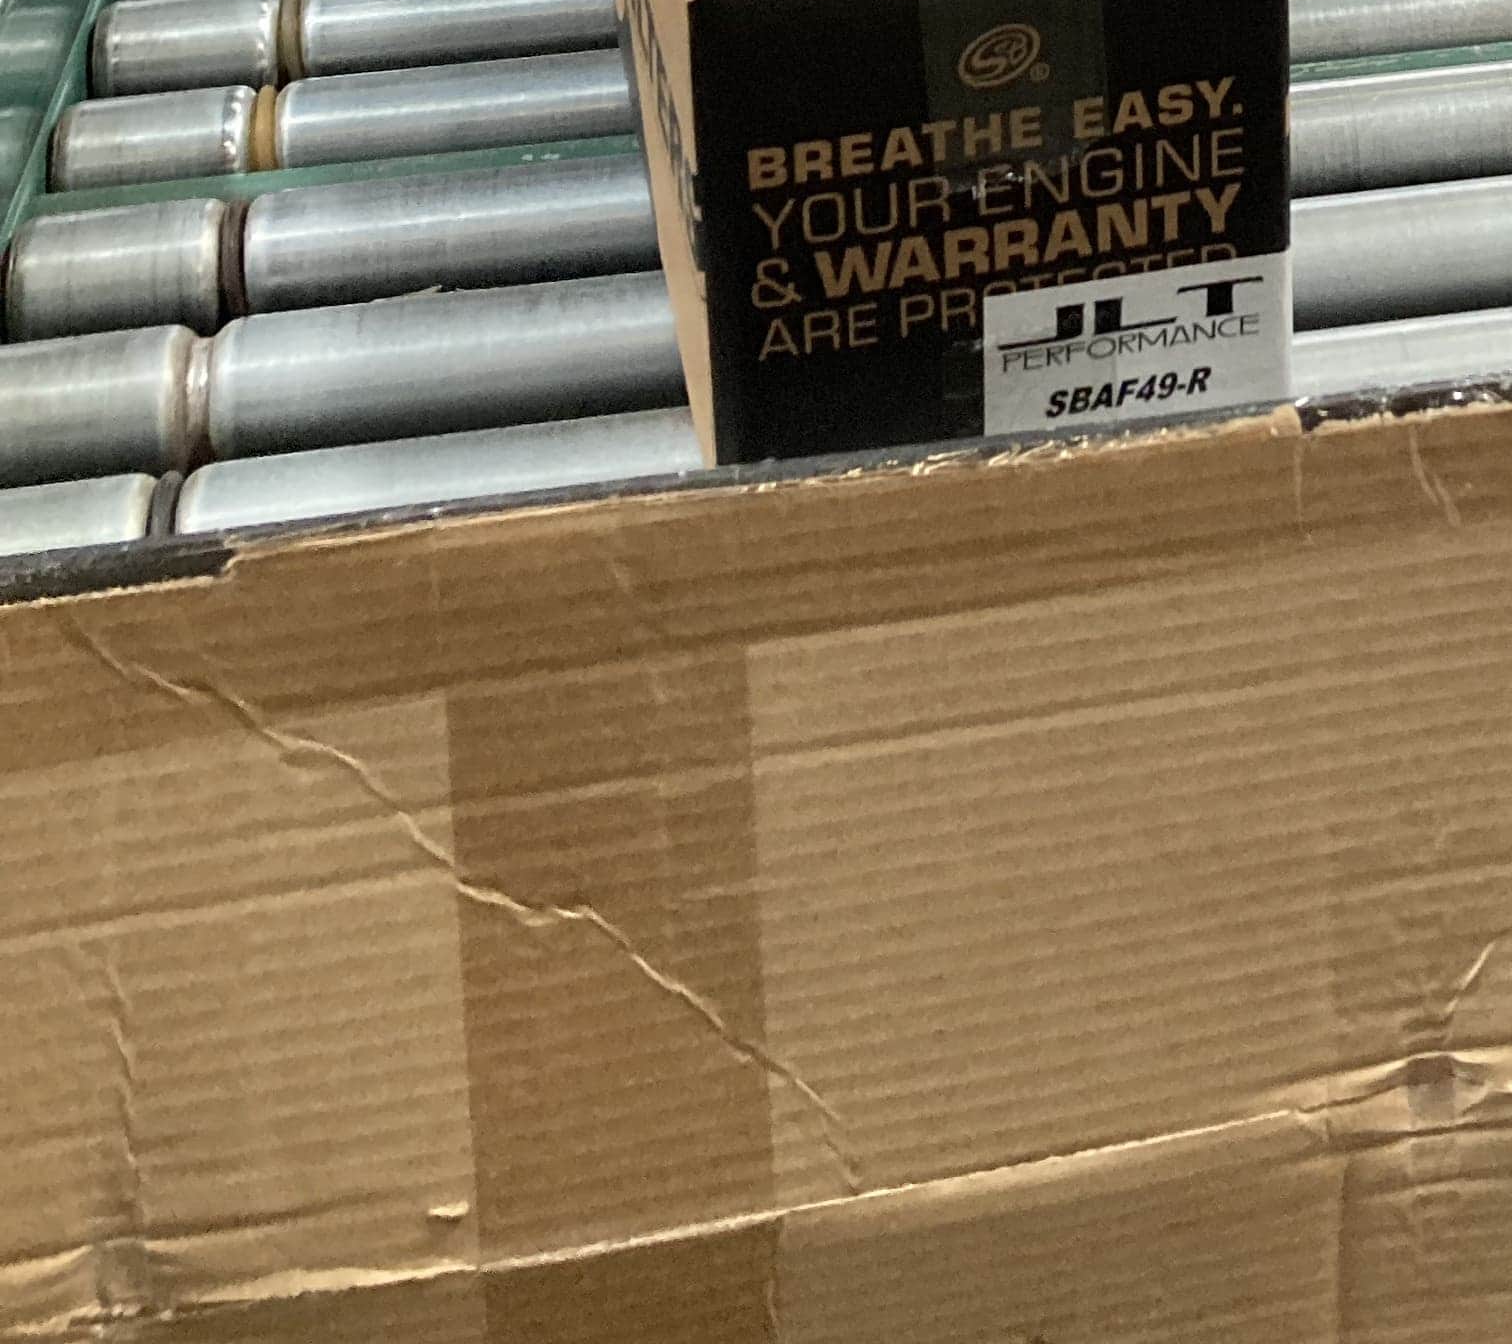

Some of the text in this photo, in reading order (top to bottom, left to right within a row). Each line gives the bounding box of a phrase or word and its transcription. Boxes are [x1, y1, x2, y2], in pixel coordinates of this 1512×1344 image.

[747, 75, 1243, 191] BREATHE EASY.
[753, 127, 1245, 252] YOUR ENGINE
[751, 257, 802, 310] &
[814, 182, 1242, 299] WARRANTY
[759, 302, 879, 361] ARE
[997, 275, 1263, 351] JLT
[1002, 314, 1260, 373] PERFORMANCE
[1045, 366, 1212, 419] SBAF49-R
